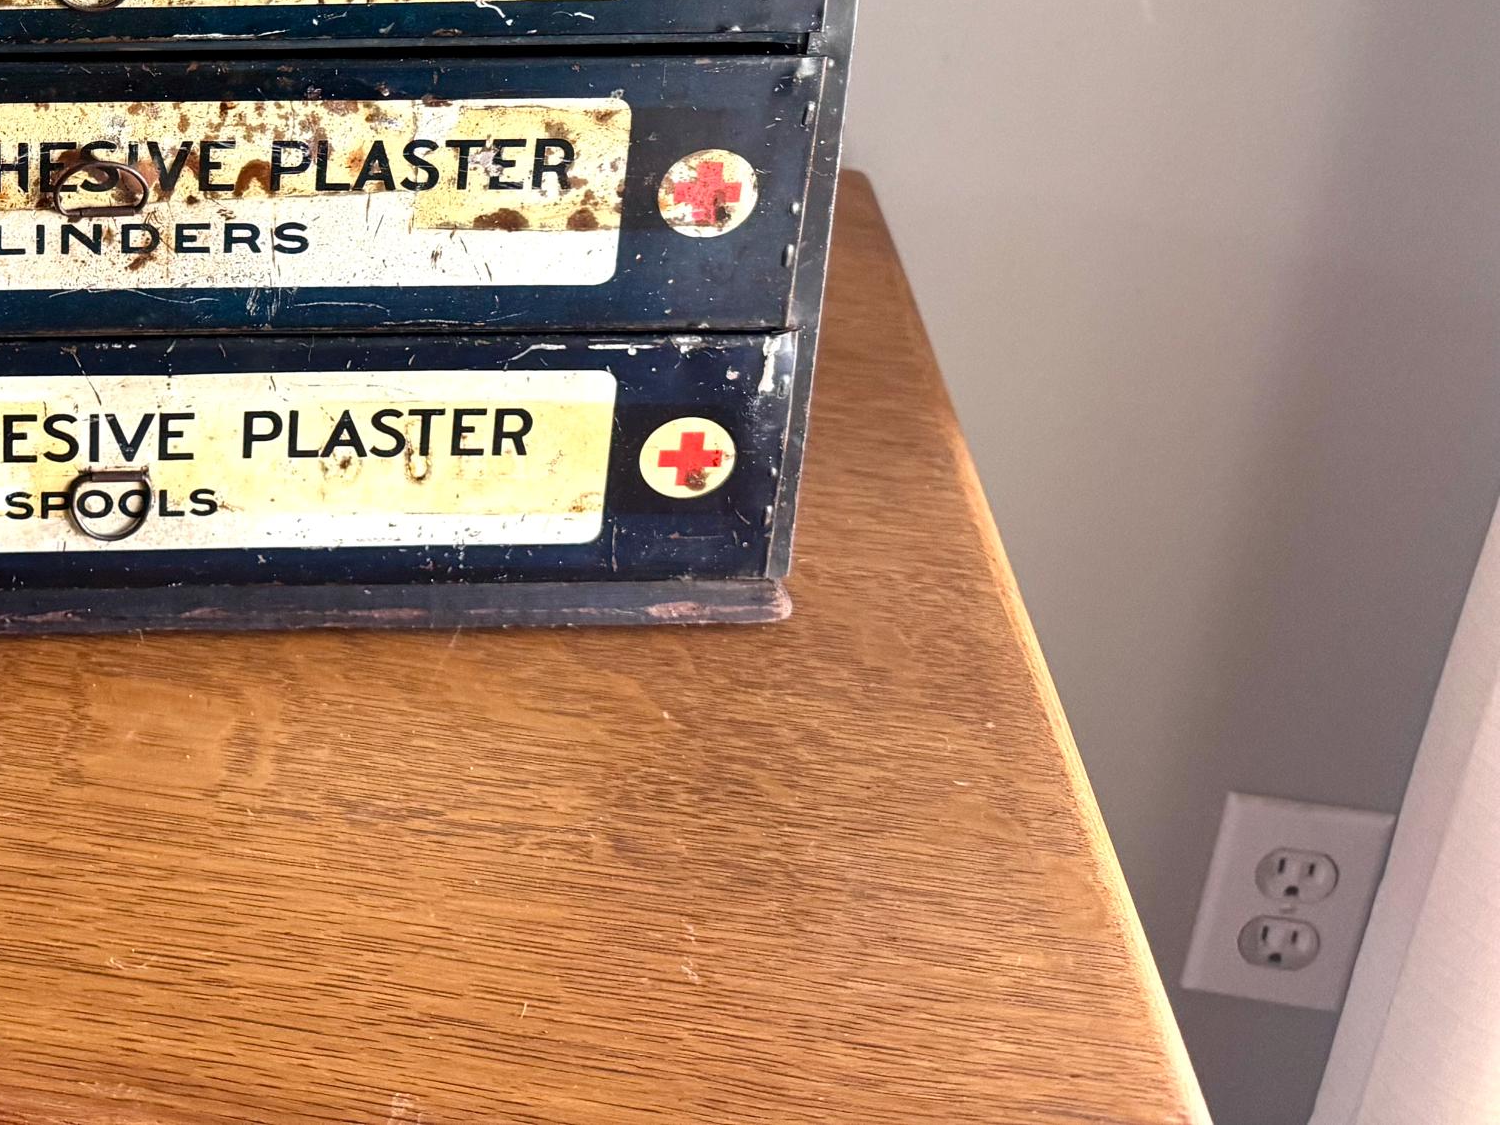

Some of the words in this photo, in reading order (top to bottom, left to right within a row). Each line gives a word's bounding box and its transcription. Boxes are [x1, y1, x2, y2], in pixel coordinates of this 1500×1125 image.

[269, 137, 576, 194] PLASTER
[242, 407, 534, 460] PLASTER
[5, 487, 219, 521] SPOOLS
